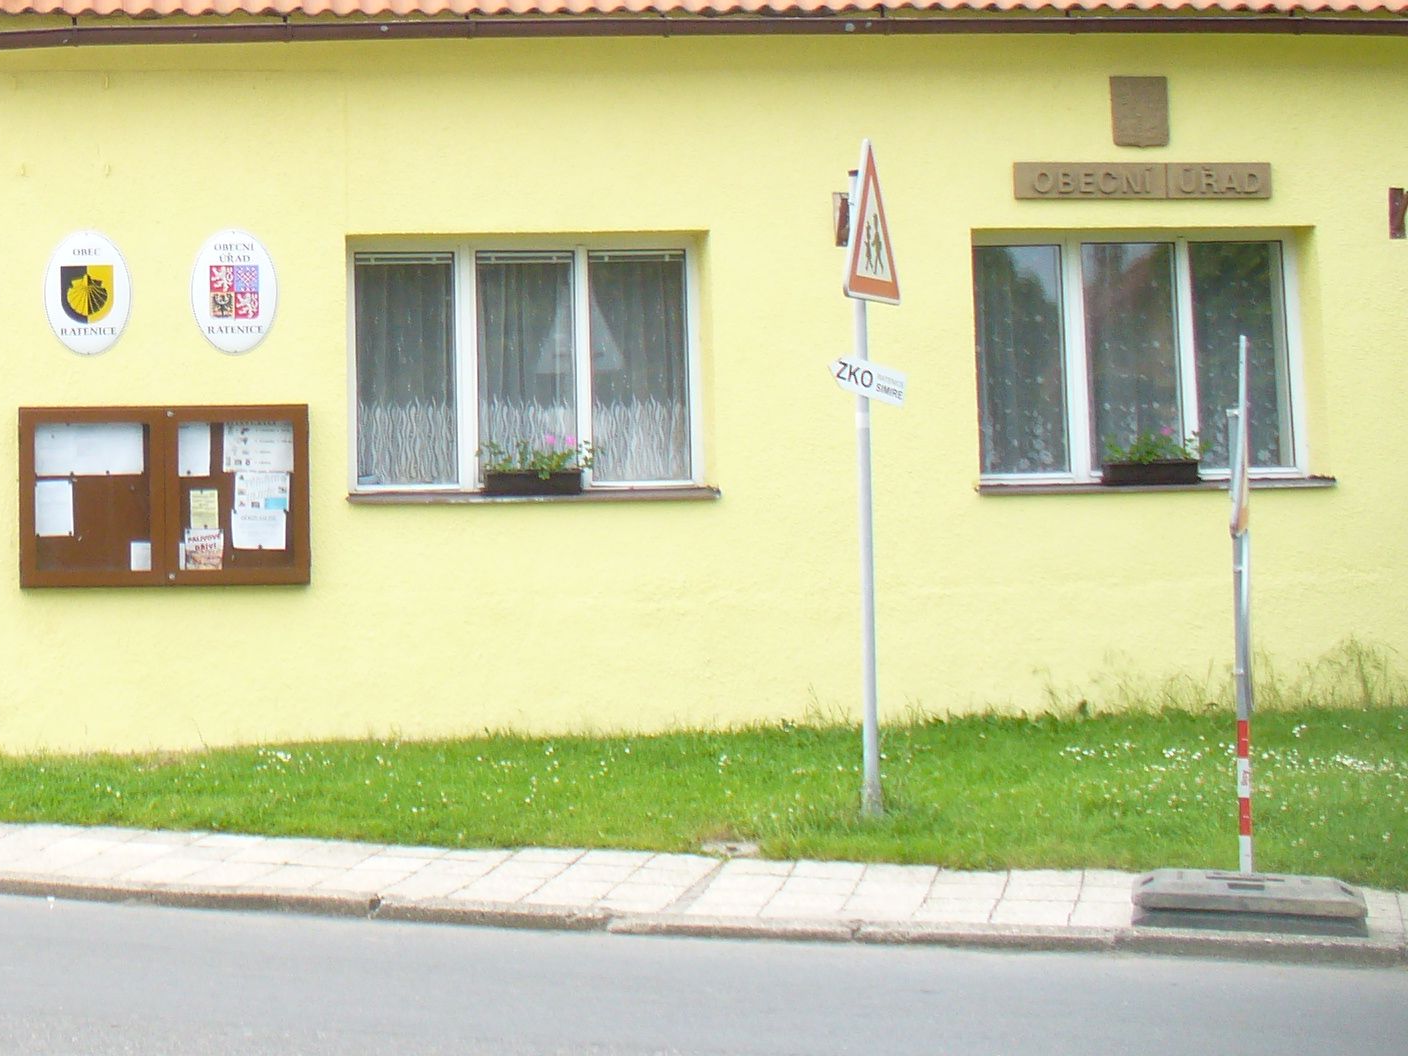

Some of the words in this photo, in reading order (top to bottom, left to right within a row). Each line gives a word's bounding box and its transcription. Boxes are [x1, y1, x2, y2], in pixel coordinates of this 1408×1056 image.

[1033, 167, 1153, 194] OBECNÍ
[1179, 166, 1262, 194] ÚŘAD
[72, 248, 101, 256] OBEC
[60, 327, 118, 336] RATENICE
[207, 326, 264, 335] RATENICE
[836, 360, 874, 388] ZKO
